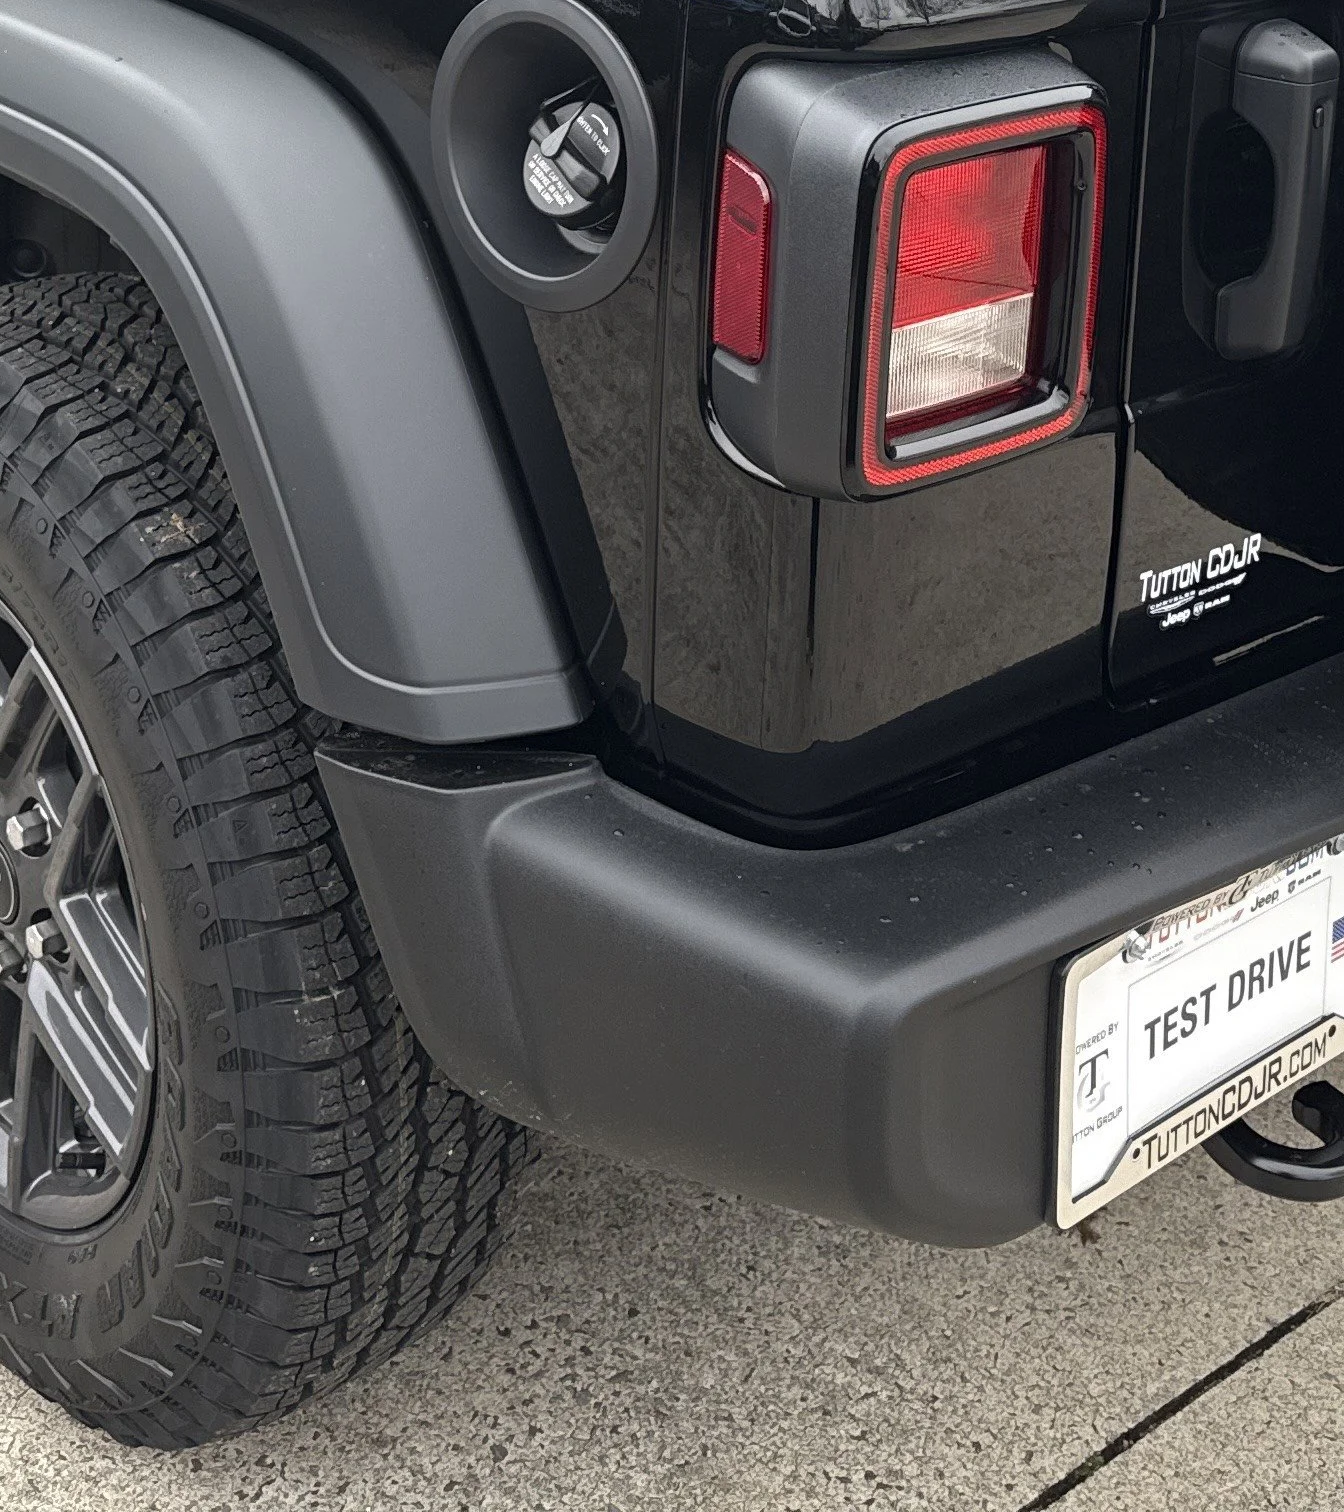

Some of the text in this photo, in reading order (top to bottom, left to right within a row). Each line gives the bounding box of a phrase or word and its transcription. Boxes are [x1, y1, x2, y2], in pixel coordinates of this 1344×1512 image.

[1139, 532, 1262, 603] TUTTON CDJR
[1162, 608, 1191, 628] Jeep
[1250, 889, 1280, 913] Jeep
[1144, 930, 1312, 1061] TEST DRIVE
[1075, 1029, 1107, 1055] OWERED
[1142, 1032, 1328, 1170] TUTTONCDJR.COM
